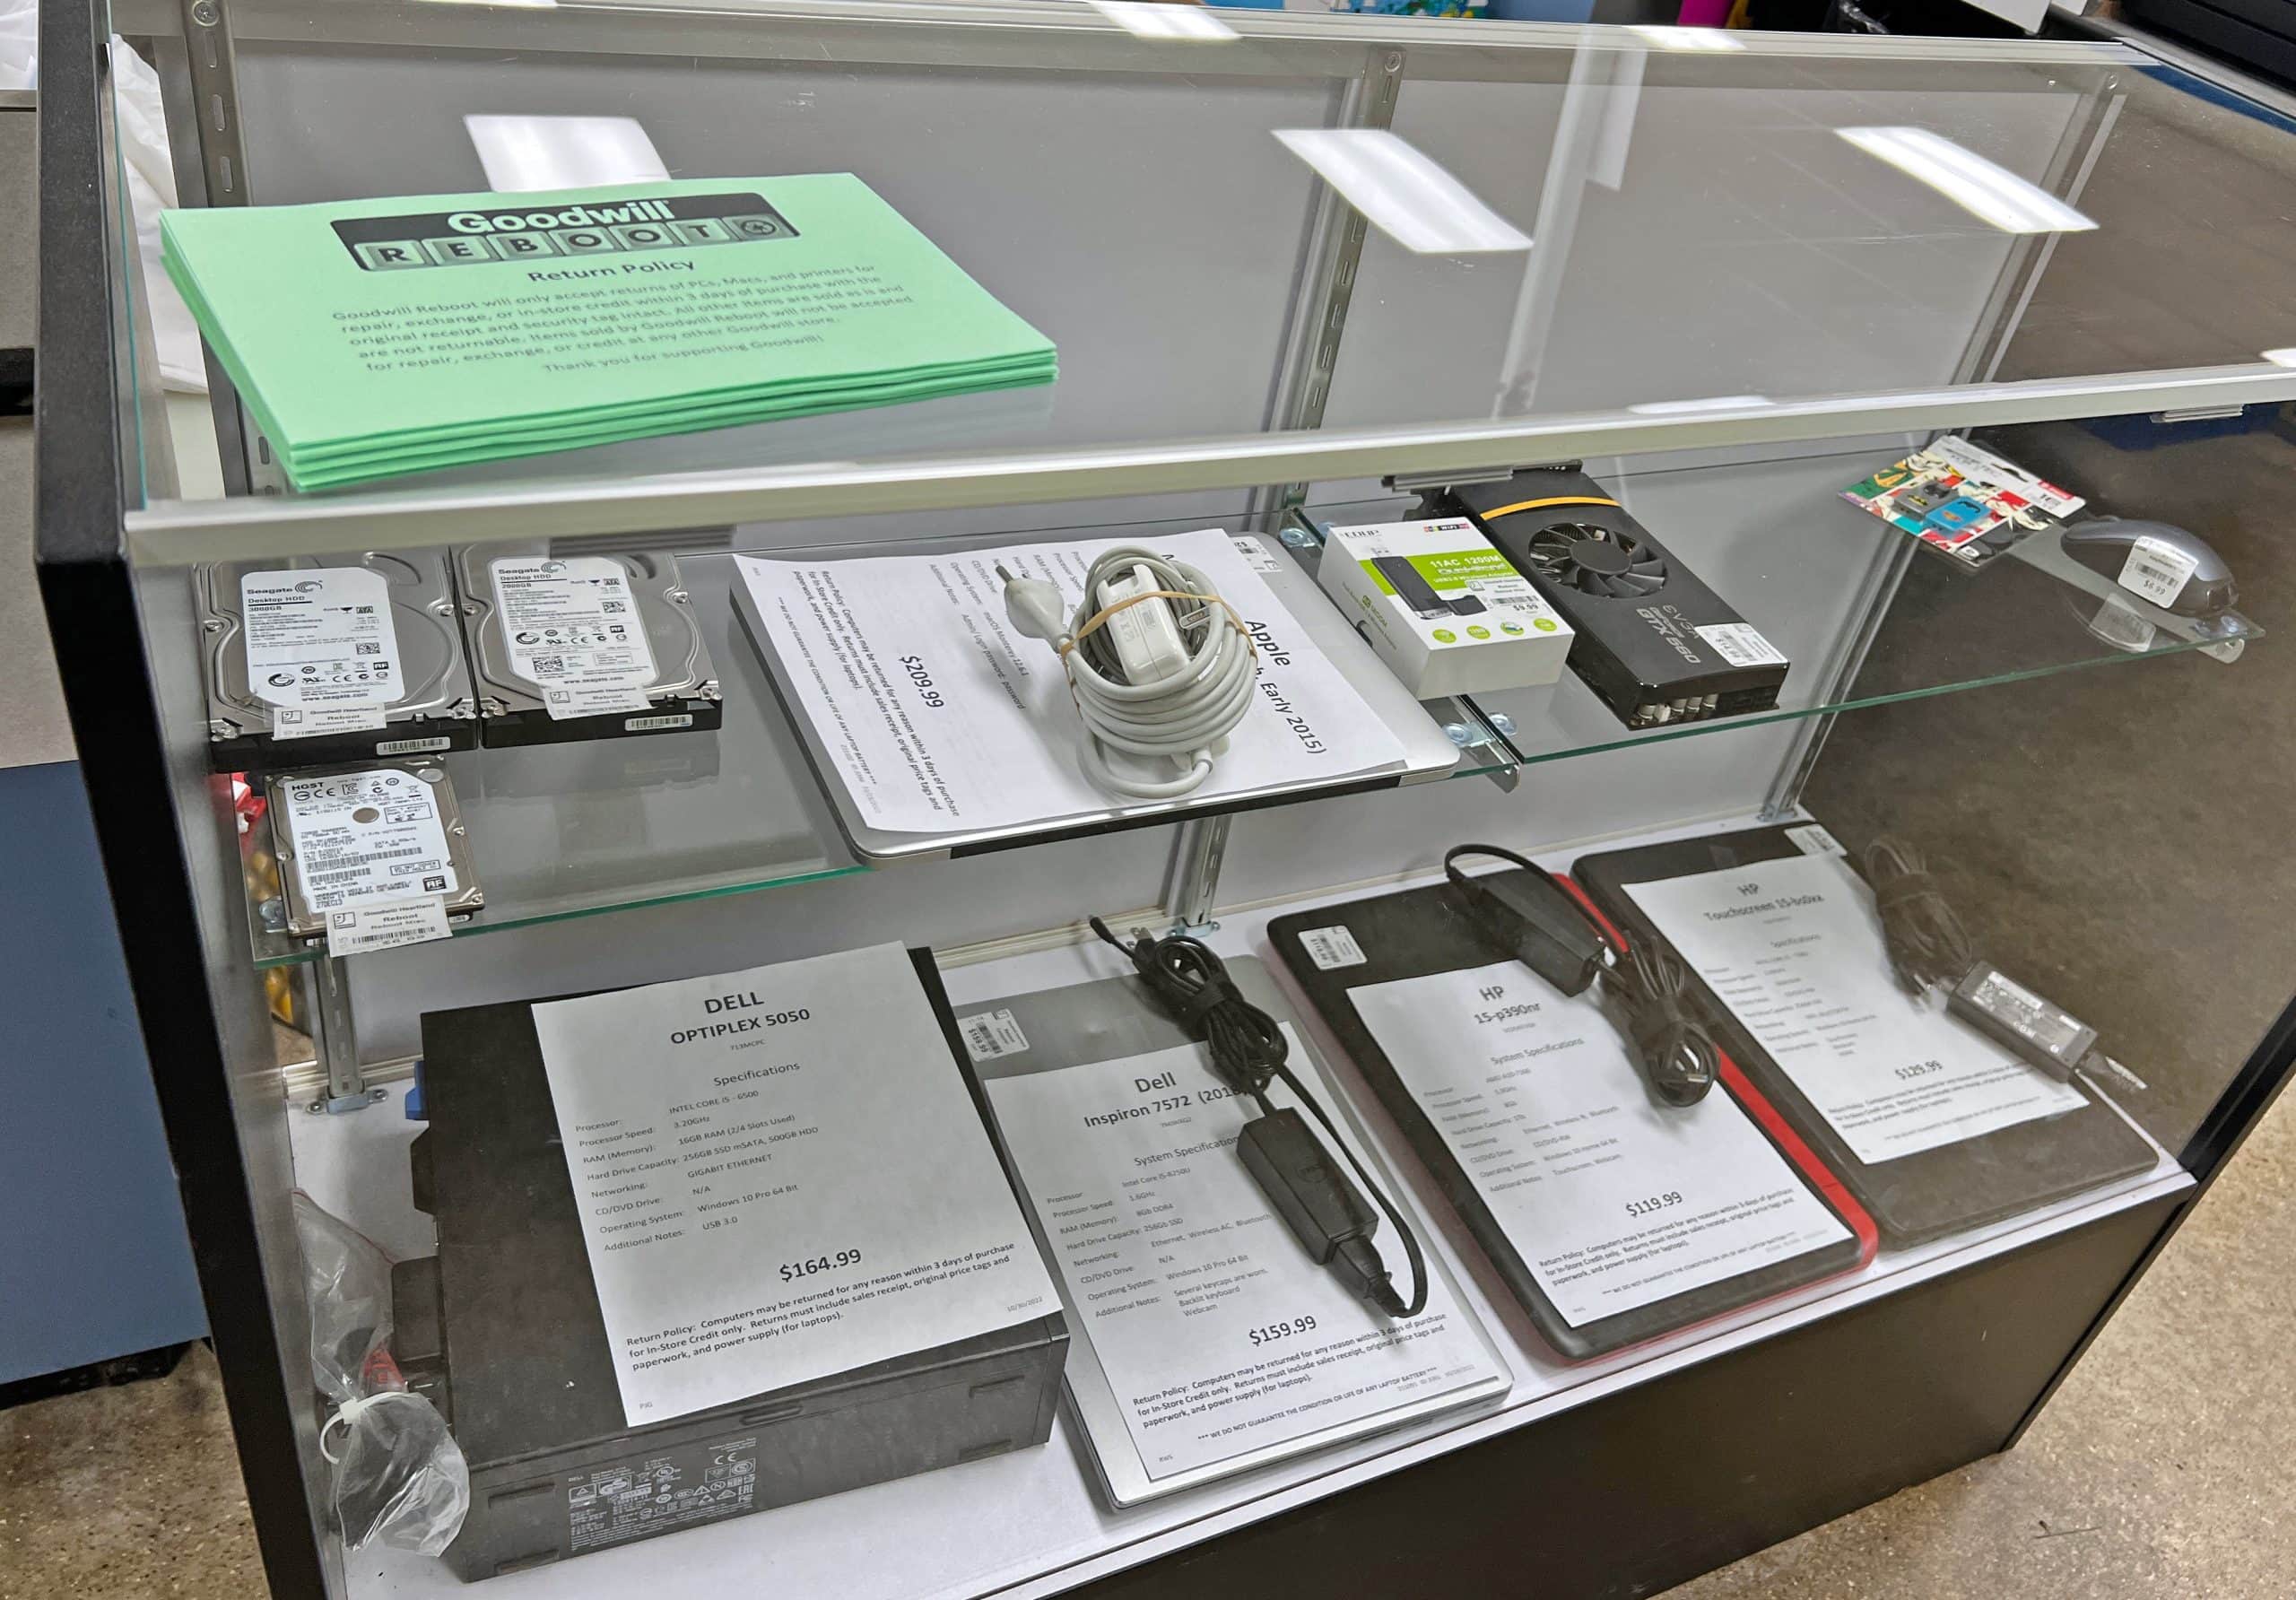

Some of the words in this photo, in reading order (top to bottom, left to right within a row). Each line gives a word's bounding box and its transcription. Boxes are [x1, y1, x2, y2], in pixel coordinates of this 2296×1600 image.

[447, 200, 674, 233] Goodwill
[378, 224, 711, 262] REBOOT
[526, 267, 617, 282] Return
[621, 260, 694, 274] Policy
[1635, 607, 1674, 637] GTX
[1244, 620, 1291, 666] Apple
[898, 655, 944, 708] $209.99
[1259, 682, 1293, 714] Early
[1285, 716, 1327, 754] 2015)
[291, 781, 325, 791] HGST
[1736, 883, 1759, 896] HP
[703, 991, 765, 1014] DELL
[1478, 985, 1505, 1002] HP
[670, 1016, 761, 1045] OPTIPLEX
[764, 1008, 811, 1027] 5050
[1489, 1051, 1526, 1065] System
[1522, 1037, 1585, 1057] Specifications
[712, 1062, 801, 1087] Specifications
[1134, 1071, 1177, 1093] Dell
[668, 1103, 695, 1115] INTEL
[694, 1098, 720, 1109] CORE
[736, 1089, 760, 1100] 6500
[1083, 1106, 1152, 1127] Inspiron
[1151, 1094, 1192, 1113] 7572
[674, 1116, 710, 1129] 3.20GHz
[677, 1134, 702, 1146] 16GB
[703, 1128, 726, 1140] RAM
[726, 1124, 746, 1136] (2/4
[746, 1120, 770, 1130] Slots
[769, 1114, 796, 1126] Used)
[578, 1134, 623, 1147] Processor
[682, 1148, 713, 1162] 256GB
[713, 1144, 732, 1155] SSD
[732, 1137, 768, 1151] mSATA,
[768, 1130, 797, 1143] 500GB
[797, 1126, 819, 1136] HDD
[1133, 1152, 1174, 1168] System
[1172, 1136, 1237, 1158] Specification
[582, 1153, 606, 1164] RAM
[686, 1163, 724, 1178] GIGABIT
[726, 1152, 772, 1170] ETHERNET
[587, 1170, 610, 1181] Hard
[611, 1166, 637, 1177] Drive
[691, 1185, 711, 1196] N/A
[696, 1198, 741, 1213] Windows
[741, 1193, 754, 1203] 10
[753, 1190, 771, 1199] Pro
[771, 1187, 785, 1196] 64
[785, 1184, 799, 1193] Bit
[1625, 1190, 1683, 1218] $119.99
[594, 1202, 634, 1216] CD/DVD
[701, 1219, 722, 1230] USB
[723, 1215, 738, 1226] 3.0
[598, 1218, 648, 1234] Operating
[604, 1234, 653, 1251] Additional
[778, 1248, 862, 1283] $164.99
[625, 1333, 662, 1346] Return
[662, 1325, 697, 1338] Policy:
[700, 1309, 755, 1328] Computers
[755, 1304, 777, 1315] may
[777, 1300, 791, 1309] be
[792, 1287, 835, 1306] returned
[835, 1285, 850, 1294] for
[852, 1280, 869, 1291] any
[870, 1272, 902, 1285] reason
[902, 1264, 933, 1277] within
[933, 1261, 941, 1270] 3
[941, 1257, 963, 1267] days
[963, 1252, 974, 1262] of
[974, 1242, 1014, 1261] purchase
[1173, 1283, 1203, 1297] Several
[1201, 1277, 1233, 1290] keycaps
[1233, 1274, 1247, 1283] are
[1246, 1267, 1268, 1278] worn.
[628, 1349, 645, 1358] for
[646, 1339, 687, 1354] In-Store
[688, 1330, 719, 1344] Credit
[720, 1324, 746, 1336] only.
[749, 1313, 788, 1328] Returns
[789, 1306, 814, 1319] must
[814, 1297, 850, 1312] include
[851, 1291, 876, 1303] sales
[875, 1282, 912, 1296] receipt,
[912, 1270, 948, 1287] original
[948, 1266, 971, 1279] price
[971, 1260, 992, 1271] tags
[992, 1254, 1011, 1266] and
[1178, 1294, 1205, 1308] Backlit
[1203, 1284, 1240, 1300] keyboard
[1182, 1303, 1218, 1317] Webcam
[631, 1351, 691, 1372] paperwork,
[692, 1343, 712, 1356] and
[713, 1336, 745, 1352] power
[746, 1327, 779, 1342] supply
[780, 1322, 799, 1335] (for
[800, 1310, 844, 1328] laptops).
[1248, 1315, 1317, 1347] $159.99
